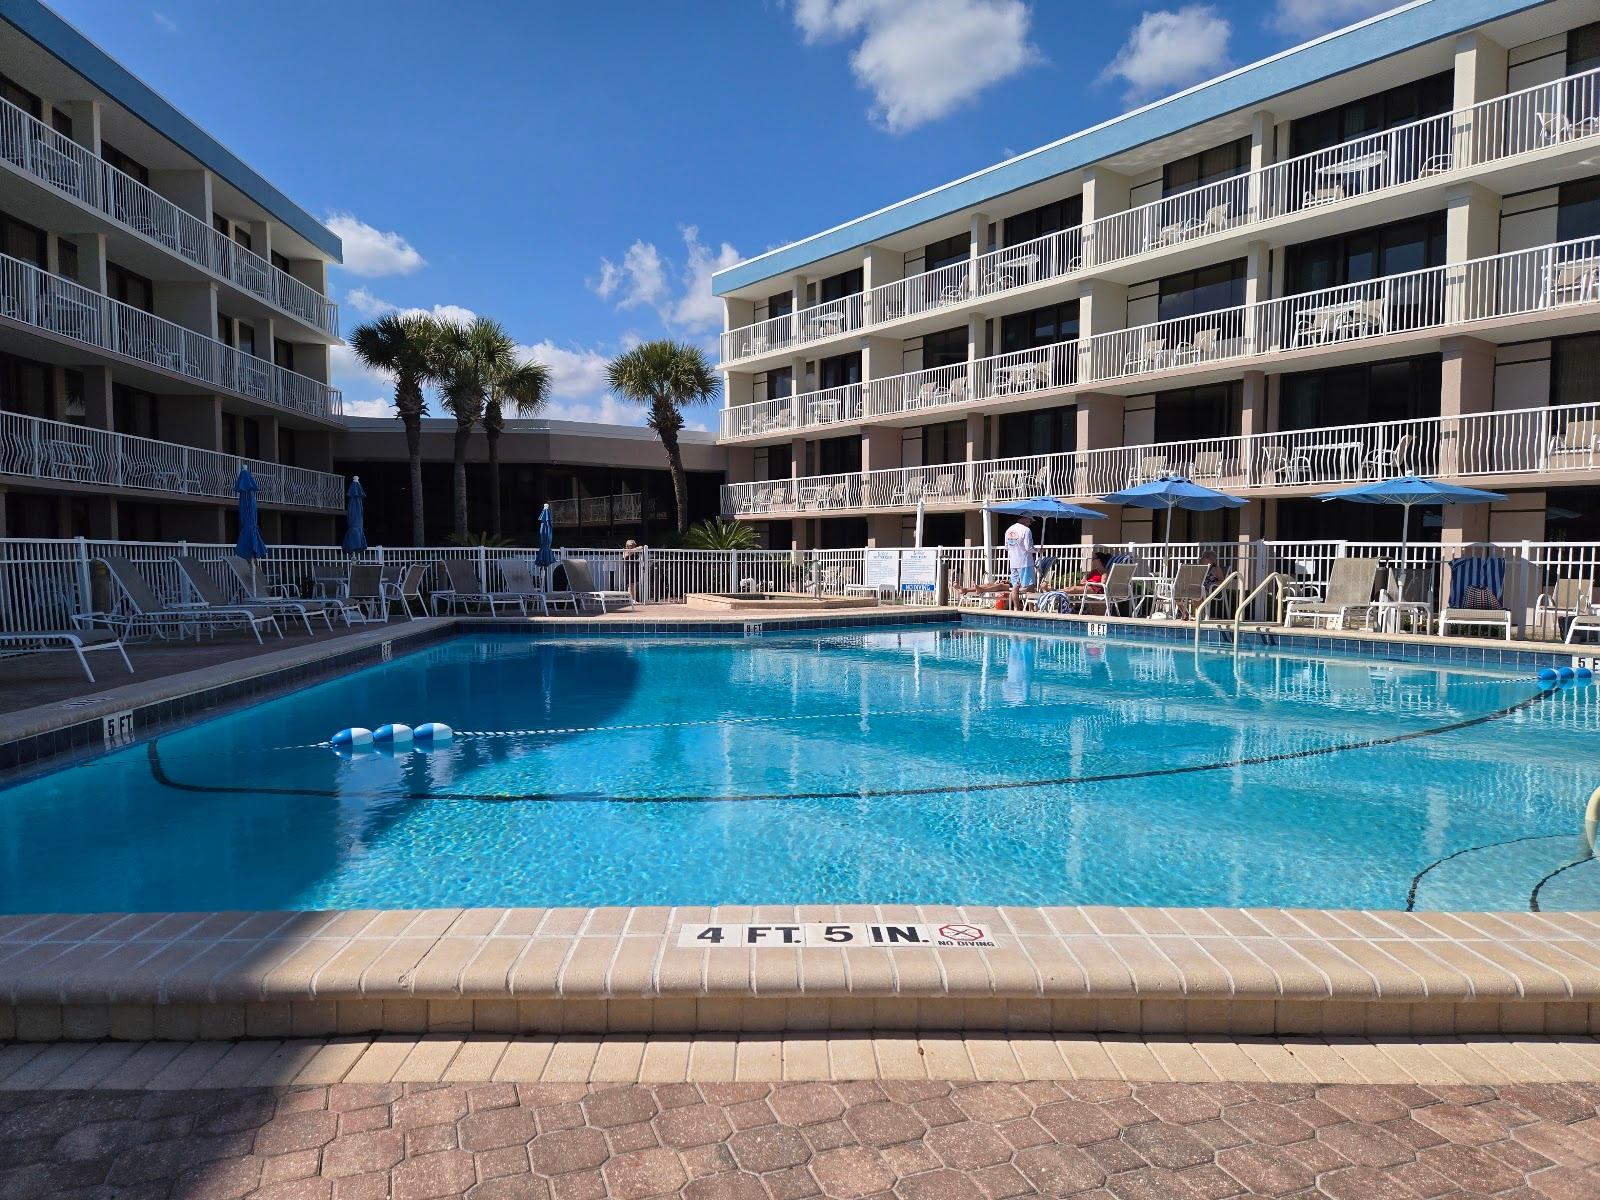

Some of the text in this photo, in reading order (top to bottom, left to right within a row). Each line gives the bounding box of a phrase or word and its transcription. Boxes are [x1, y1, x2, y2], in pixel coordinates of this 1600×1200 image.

[746, 624, 751, 633] 8
[1090, 623, 1095, 632] 8
[1577, 656, 1600, 670] 5 F
[107, 718, 115, 737] 5
[696, 925, 930, 944] 4 FT. 5 IN.
